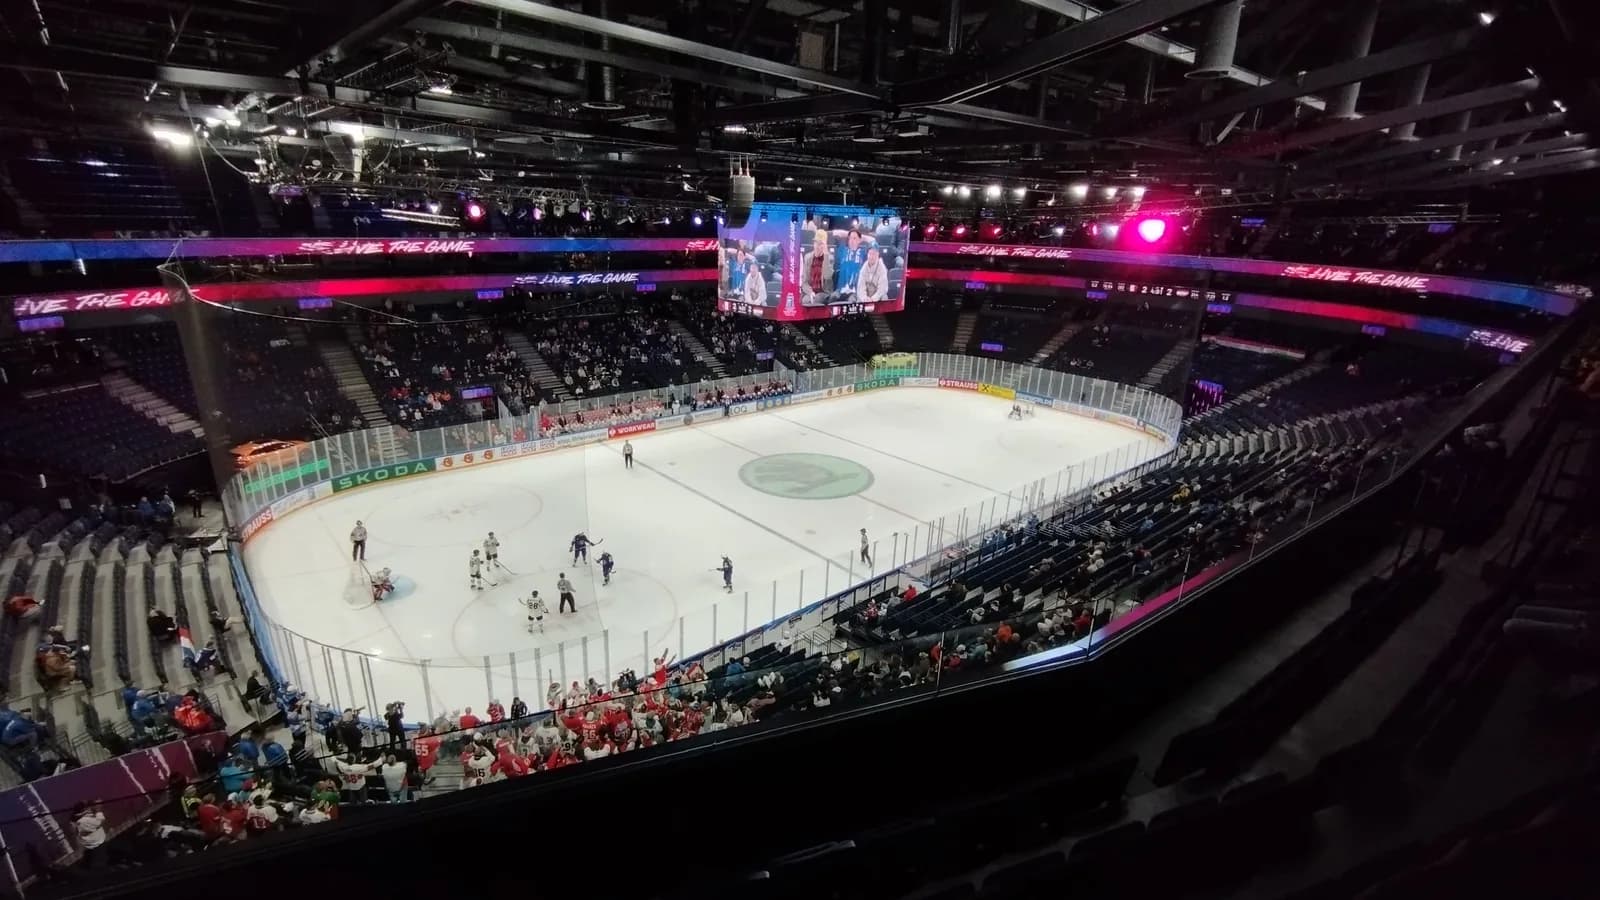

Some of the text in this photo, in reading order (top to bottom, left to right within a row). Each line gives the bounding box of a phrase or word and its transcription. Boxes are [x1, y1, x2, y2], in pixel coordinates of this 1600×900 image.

[331, 240, 385, 254] LIVE
[388, 240, 425, 253] THE
[424, 240, 475, 253] GAME
[1011, 247, 1036, 256] THE
[1035, 248, 1072, 258] GAME
[539, 274, 574, 284] LIVE
[577, 273, 603, 284] THE
[602, 273, 639, 283] GAME
[1309, 267, 1352, 281] LIVE
[1353, 271, 1384, 283] THE
[1381, 274, 1429, 288] GAME
[1166, 288, 1173, 296] 2
[75, 293, 128, 310] THE
[946, 380, 978, 390] STRAUSS
[617, 422, 655, 434] WORKWEAR
[415, 744, 429, 757] 65
